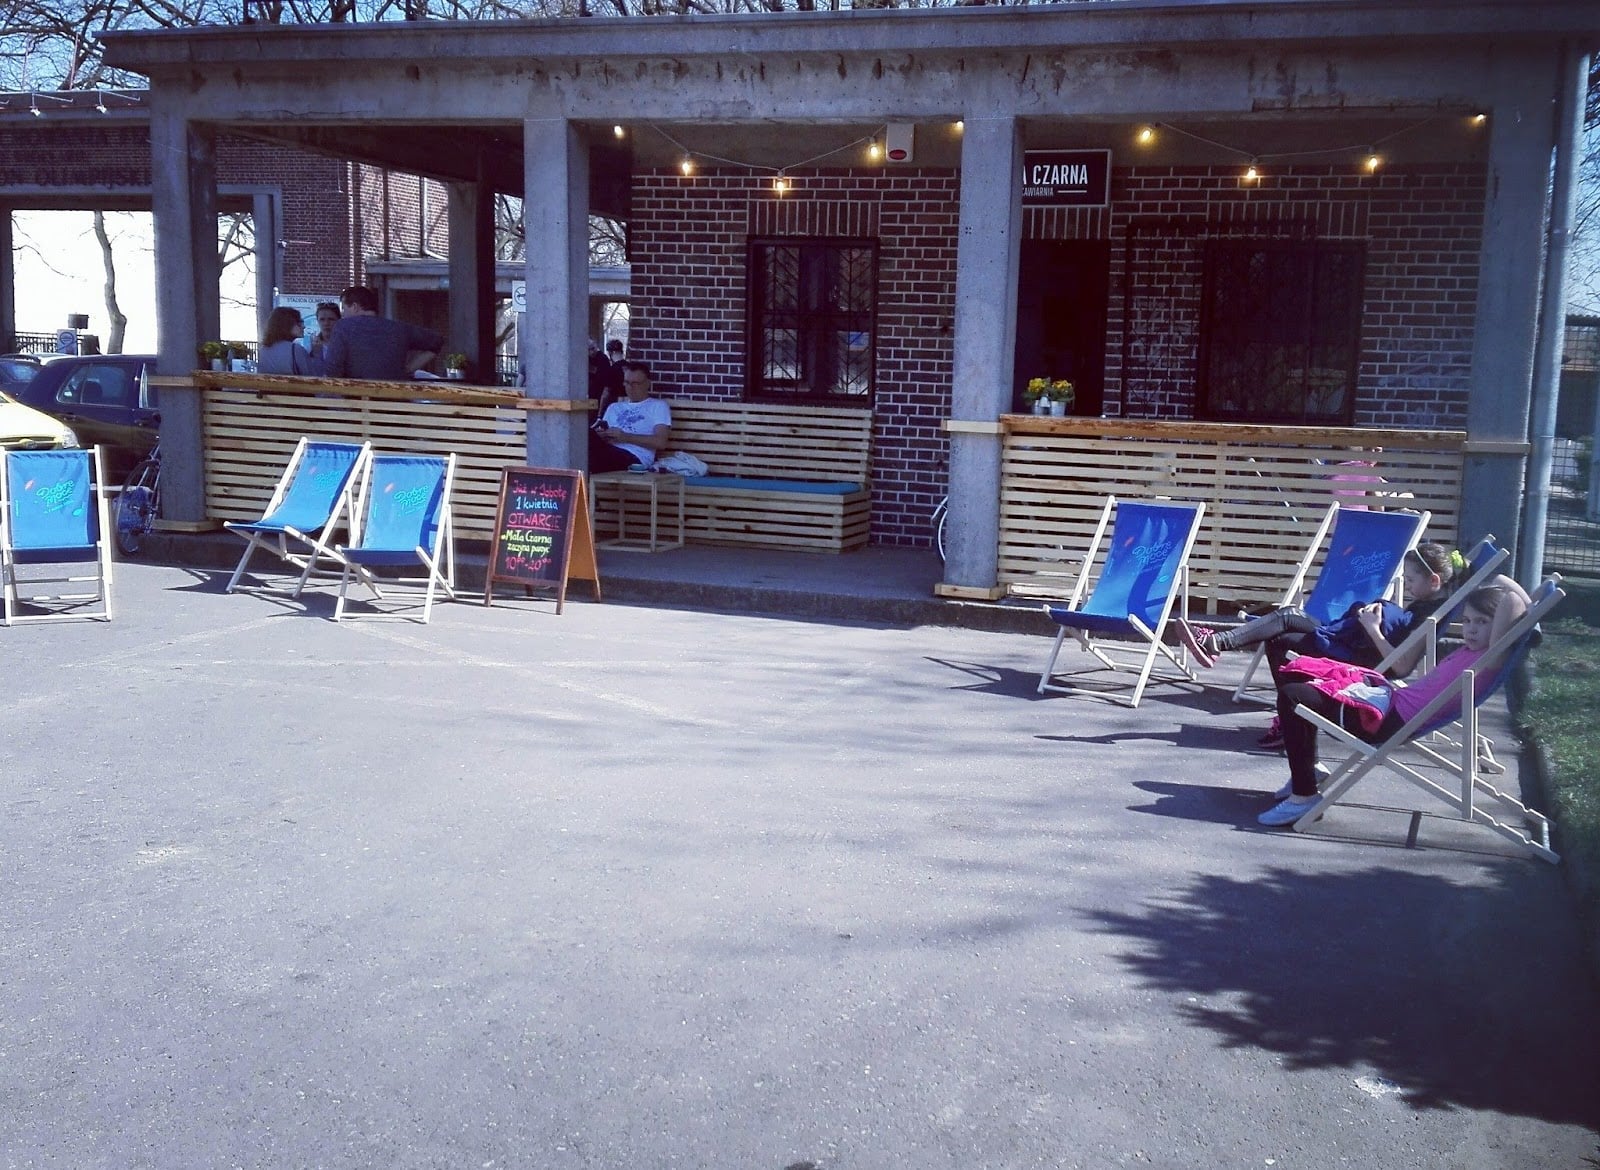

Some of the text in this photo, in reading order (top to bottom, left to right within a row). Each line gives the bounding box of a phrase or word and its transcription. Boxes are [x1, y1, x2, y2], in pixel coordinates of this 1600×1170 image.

[1033, 164, 1088, 185] CZARNA
[516, 496, 558, 510] 1 kwietnia
[508, 513, 562, 528] OTWARCIE
